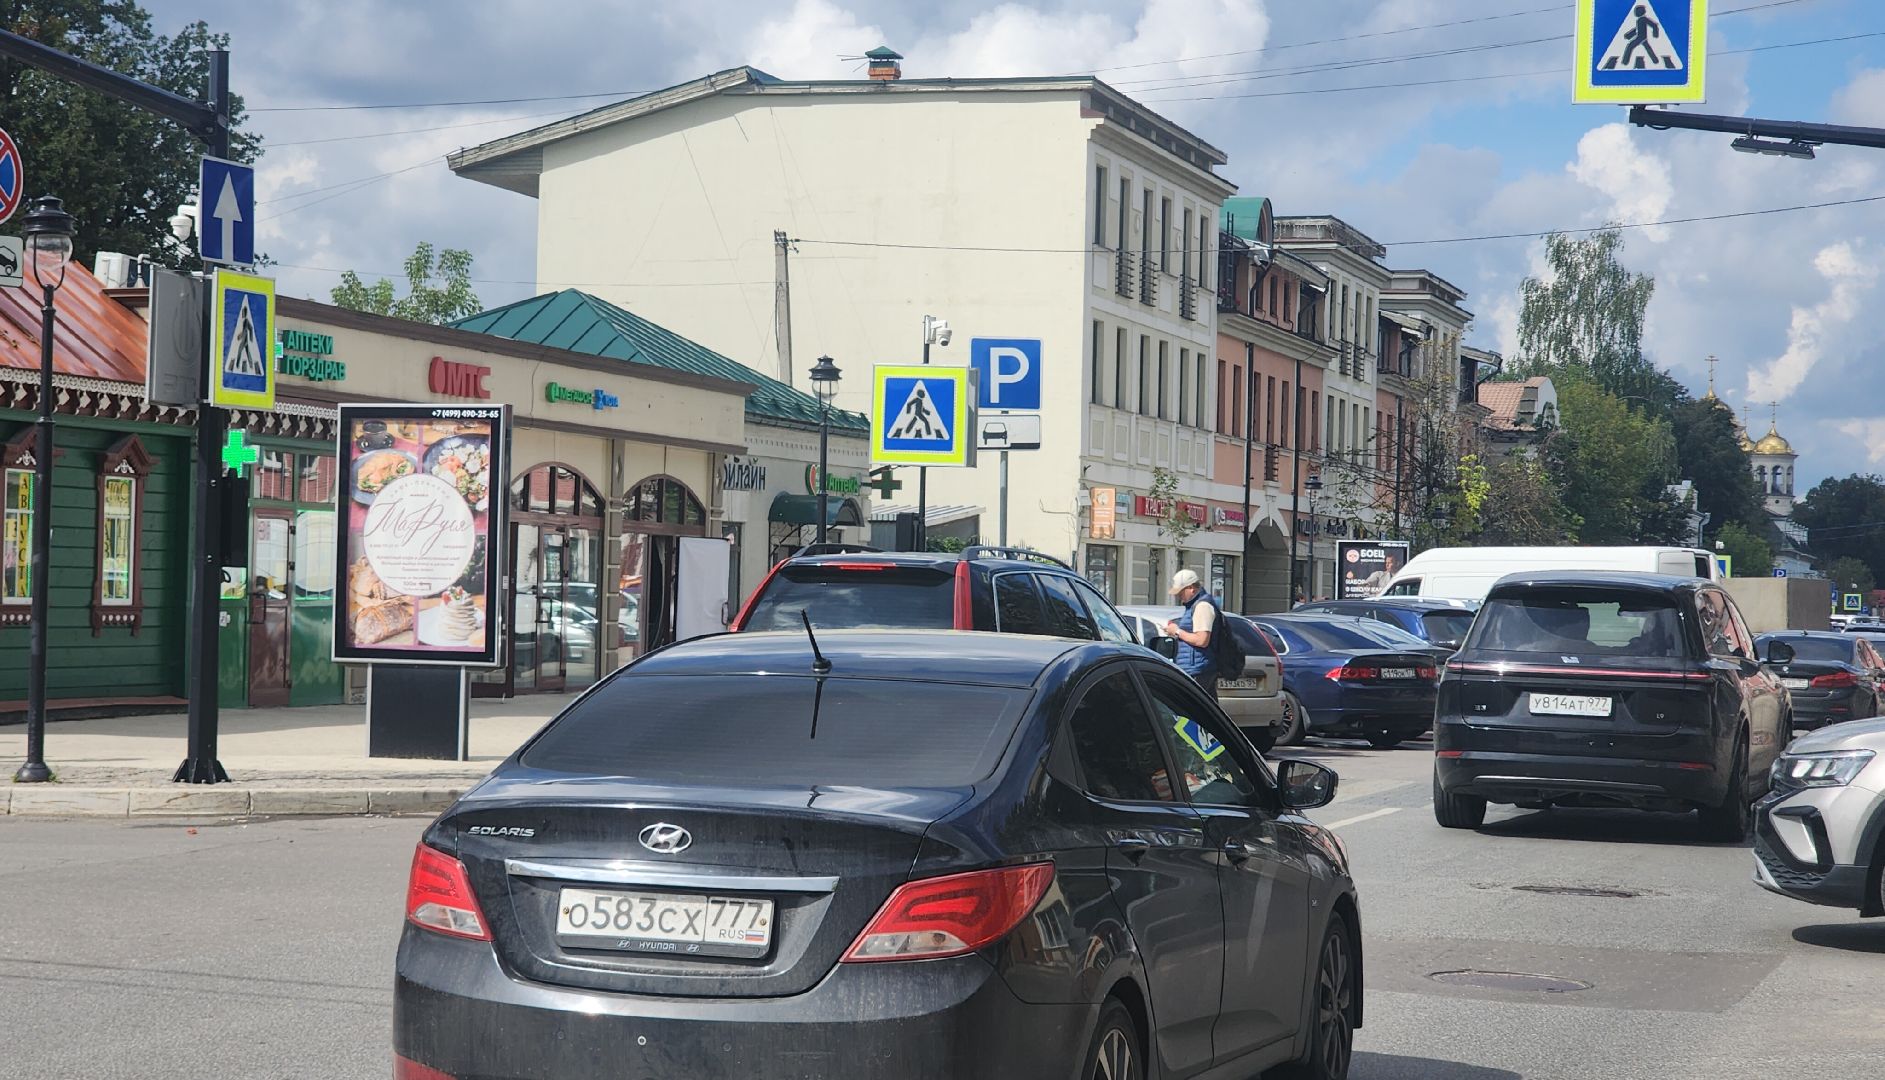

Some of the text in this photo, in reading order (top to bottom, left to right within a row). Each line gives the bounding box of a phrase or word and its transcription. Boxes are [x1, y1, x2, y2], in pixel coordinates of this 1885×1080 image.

[284, 331, 333, 354] АПТЕКИ
[284, 356, 346, 381] ГОРЗДРАВ
[447, 362, 491, 399] МТС
[990, 348, 1029, 403] P
[442, 410, 461, 418] (499)
[461, 410, 499, 418] 490-25-65
[1360, 549, 1385, 558] БОЕЦ
[1534, 697, 1608, 710] У814АТ 977
[468, 826, 535, 837] SOLARIS
[568, 895, 763, 936] О583СХ 777
[718, 929, 745, 940] RUS
[639, 942, 677, 951] HYUNDAI
